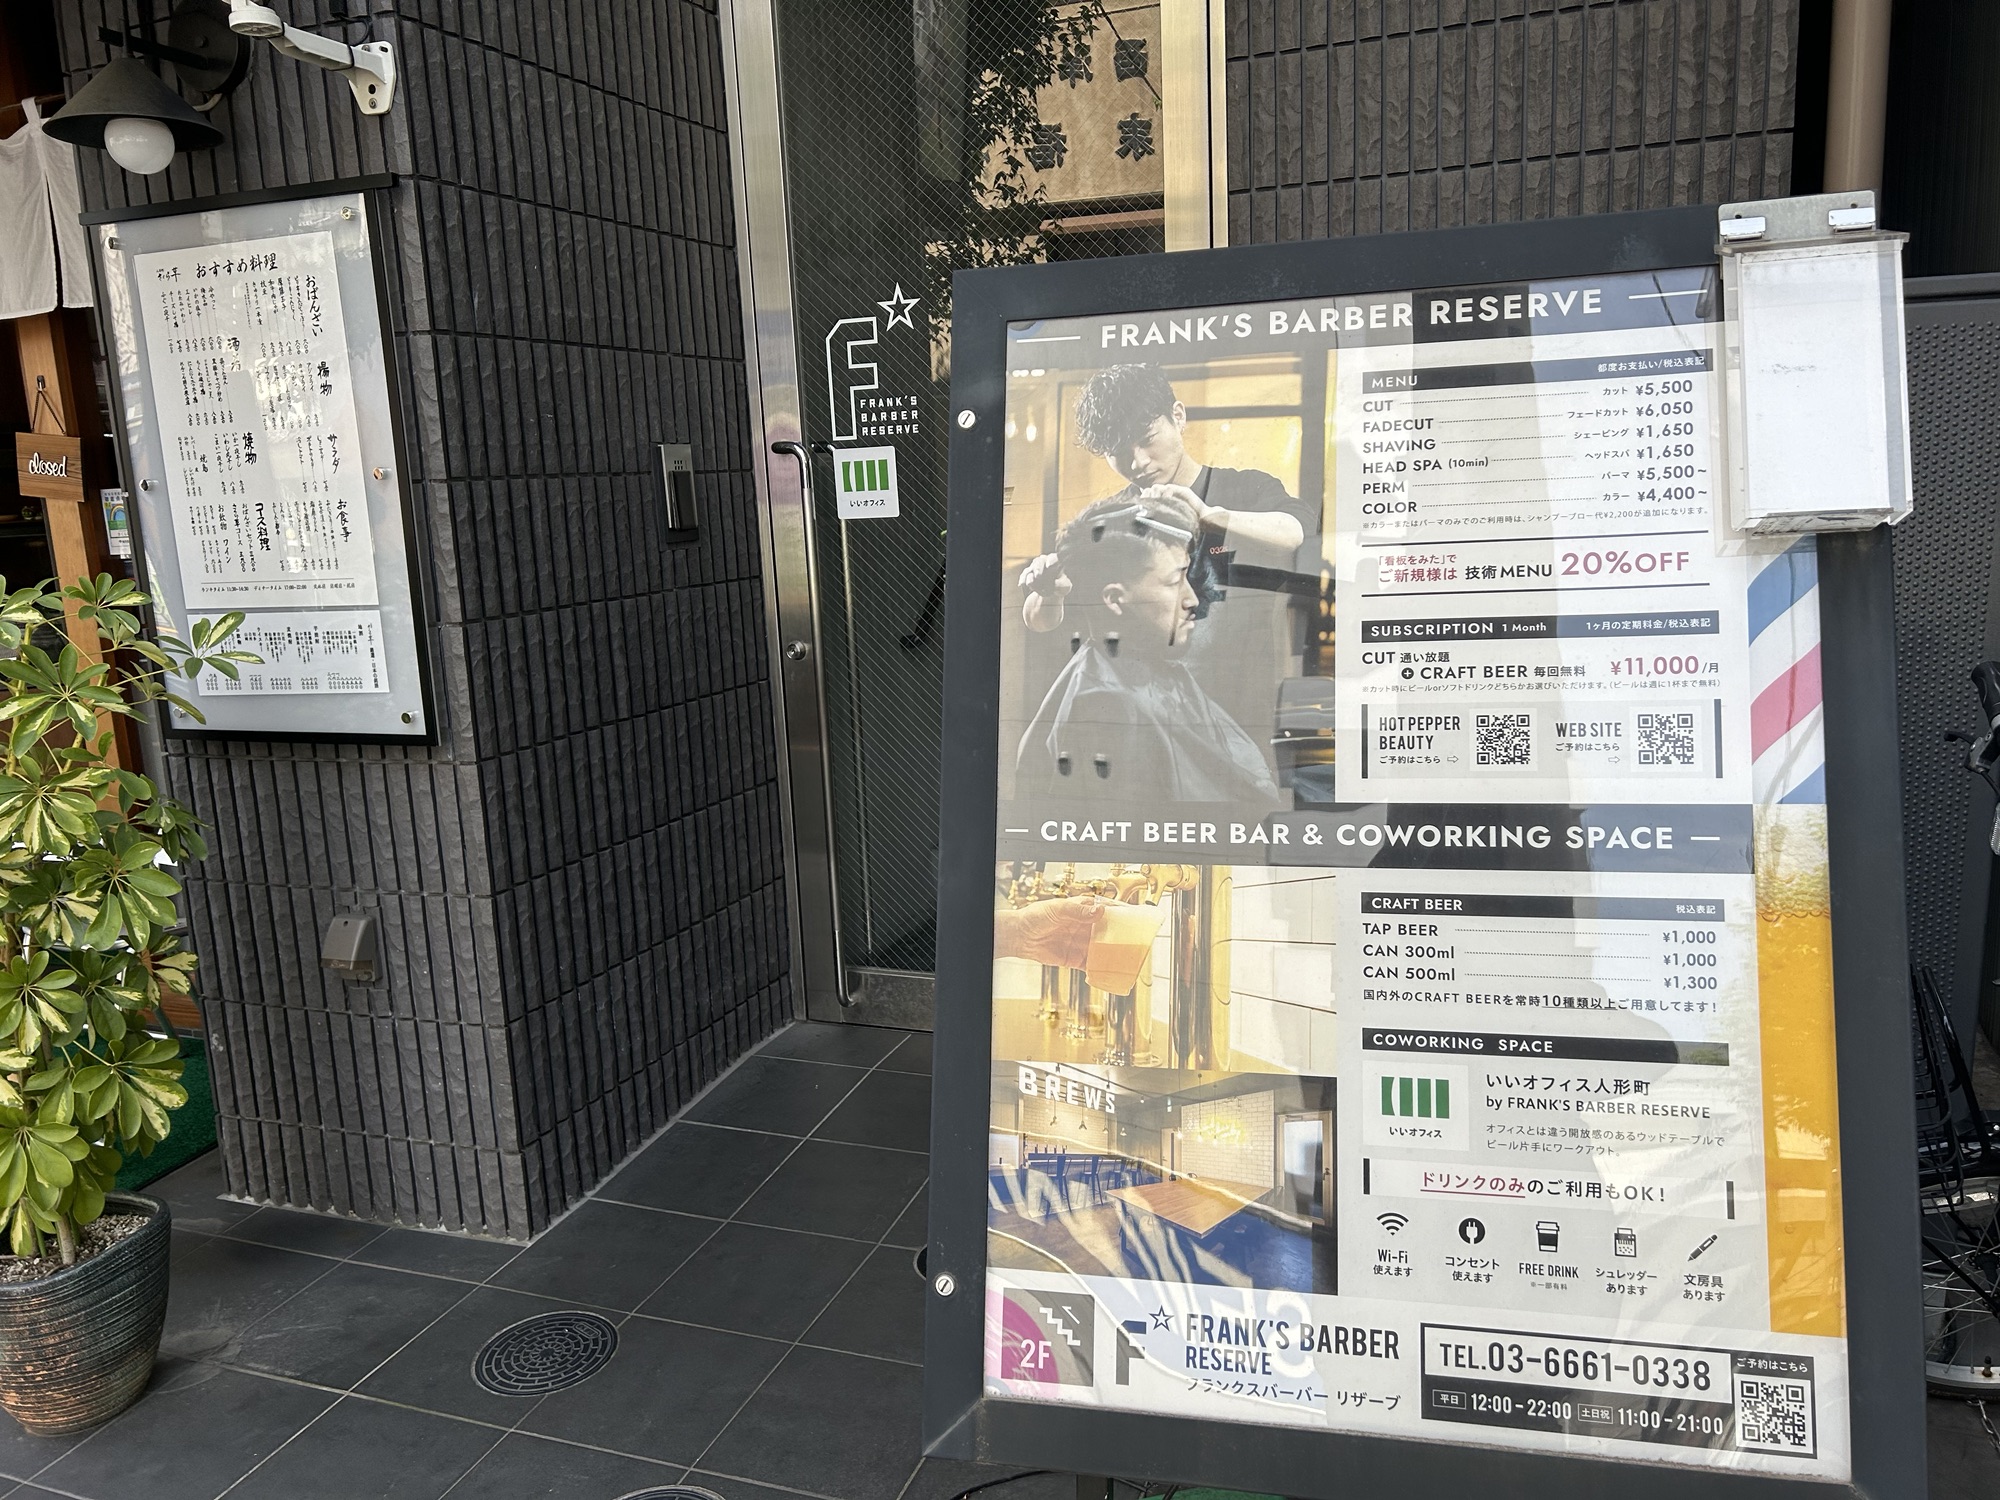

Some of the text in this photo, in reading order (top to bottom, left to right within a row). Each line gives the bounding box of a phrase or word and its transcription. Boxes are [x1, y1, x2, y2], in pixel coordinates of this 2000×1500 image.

[196, 252, 278, 279] おすすめ料理
[306, 275, 324, 337] おばんざい
[1101, 289, 1602, 348] FRANK'S BARBER RESERVE
[1597, 356, 1705, 373] 都度お支払い/税込表記
[317, 361, 333, 397] 揚物
[1371, 375, 1418, 389] MENU
[860, 395, 917, 408] FRANK'S
[1362, 379, 1692, 413] CUT カット ¥5,500
[861, 410, 918, 422] BARBER
[1362, 401, 1693, 433] FADECUT フェードカット ¥6,050
[862, 424, 919, 436] RESERVE
[1362, 422, 1693, 454] SHAVING シェービング ¥1,650
[242, 431, 257, 466] 焼物
[327, 433, 341, 474] サラダ
[1362, 443, 1694, 475] HEAD SPA (10min) ヘッドスパ ¥1,650
[29, 452, 67, 477] closed
[1362, 481, 1405, 495] PERM
[1601, 471, 1630, 480] パーマ
[850, 499, 886, 507] いいオフィス
[1362, 501, 1417, 515] COLOR
[1603, 493, 1630, 501] カラー
[255, 502, 271, 551] コース料理
[336, 499, 352, 543] お食事
[223, 538, 231, 564] ワイン
[1378, 553, 1457, 566] 「看板をみた」で
[1561, 551, 1690, 577] 20%OFF
[1379, 567, 1457, 583] ご新規様は
[1371, 622, 1547, 638] SUBSCRIPTION 1 Month
[1362, 651, 1450, 665] CUT 通い放題
[1420, 665, 1587, 680] CRAFT BEER 毎回無料
[1379, 716, 1461, 732] HOT PEPPER
[1555, 722, 1622, 738] WEB SITE
[1379, 736, 1434, 750] BEAUTY
[1555, 742, 1620, 752] ご予約はこちら
[1379, 755, 1441, 765] ご予約はこちら
[1040, 821, 1674, 850] CRAFT BEER BAR & COWORKING SPACE
[1372, 897, 1463, 911] CRAFT BEER
[1676, 904, 1716, 915] 税込表記
[1363, 923, 1716, 945] TAP BEER ¥1,000
[1363, 944, 1717, 968] CAN 300ml ¥1,000
[1363, 966, 1717, 990] CAN 500ml ¥1,300
[1372, 1033, 1553, 1053] COWORKING SPACE
[1019, 1065, 1115, 1114] BREWS
[1486, 1073, 1651, 1096] いいオフィス人形町
[1486, 1096, 1711, 1119] by FRANK'S BARBER RESERVE
[1389, 1126, 1443, 1139] いいオフィス
[1486, 1123, 1725, 1147] オフィスとは違う開放感のあるウッドテーブルで
[1487, 1139, 1621, 1157] ビール片手にワークアウト。
[1377, 1249, 1409, 1264] Wi-Fi
[1445, 1255, 1500, 1270] コンセント
[1373, 1264, 1413, 1277] 使えます
[1452, 1270, 1493, 1284] 使えます
[1519, 1262, 1579, 1278] FREE DRINK
[1595, 1267, 1658, 1281] シュレッダー
[1683, 1273, 1724, 1288] 文房具
[1606, 1282, 1648, 1296] あります
[1683, 1289, 1726, 1302] あります
[1186, 1313, 1400, 1360] FRANK'S BARBER
[1020, 1339, 1052, 1369] 2F
[1185, 1347, 1272, 1376] RESERVE
[1439, 1341, 1711, 1391] TEL.03-6661-0338
[1736, 1357, 1808, 1373] ご予約はこちら
[1187, 1378, 1401, 1411] フランクスバーバー リザーブ
[1440, 1394, 1460, 1405] 平日
[1581, 1407, 1611, 1421] 土日祝
